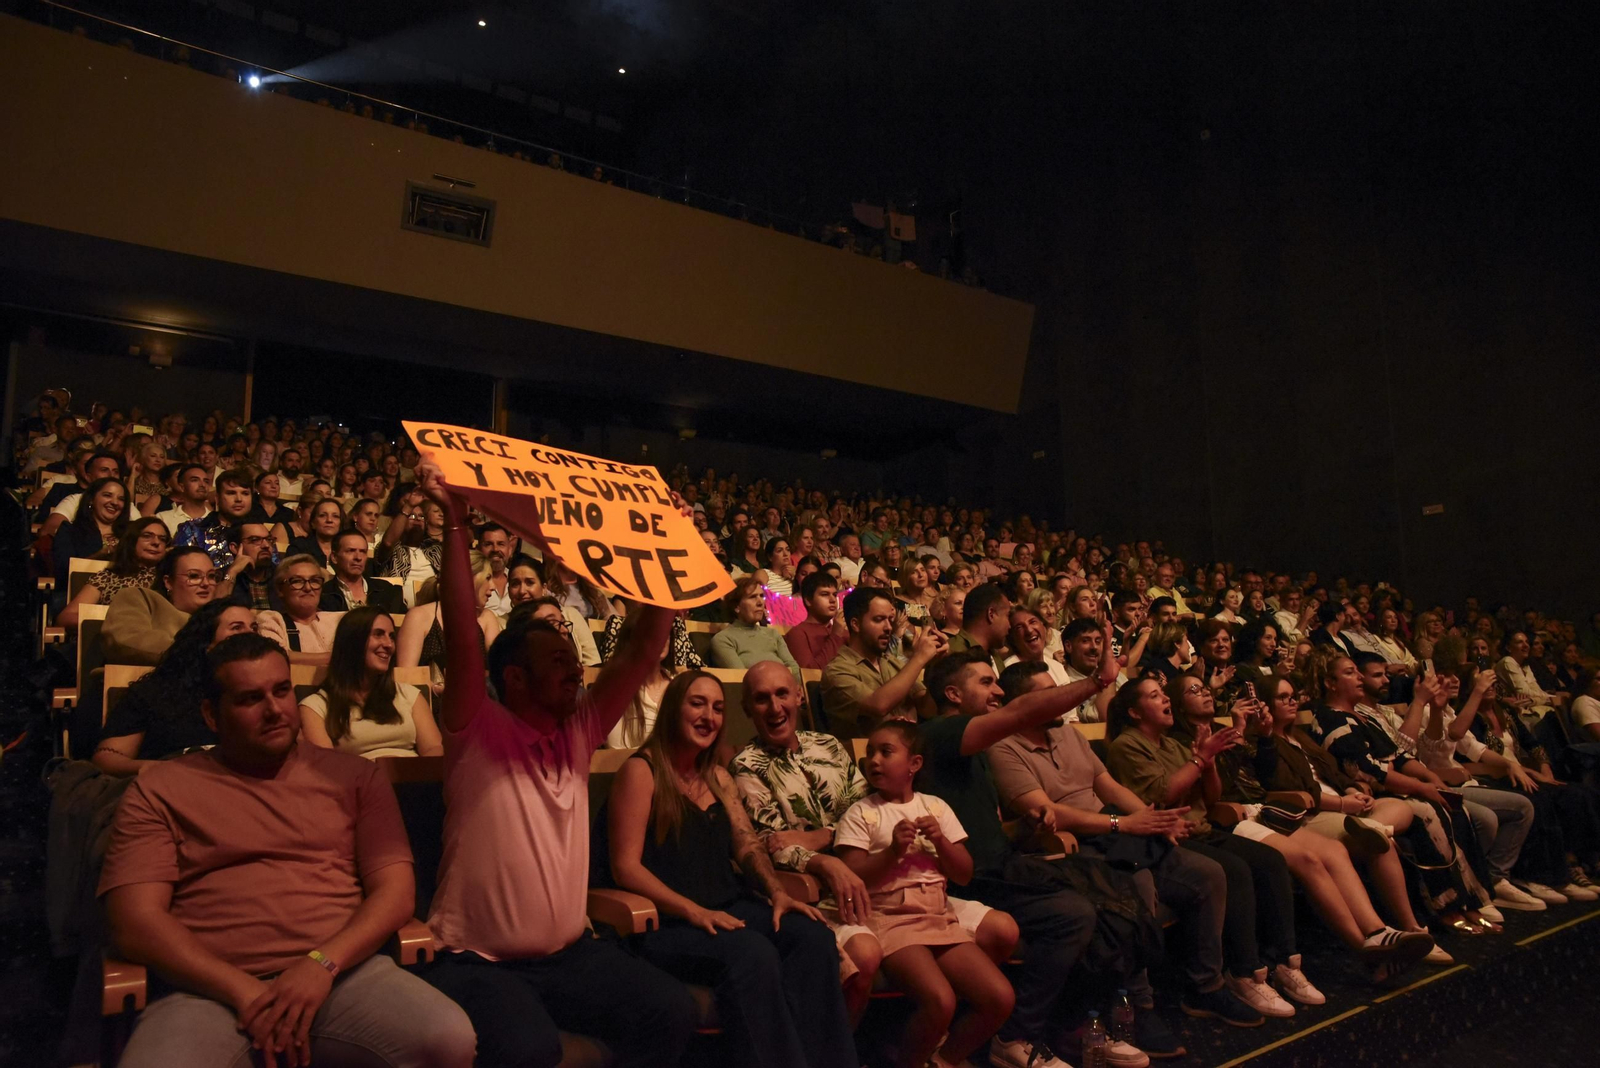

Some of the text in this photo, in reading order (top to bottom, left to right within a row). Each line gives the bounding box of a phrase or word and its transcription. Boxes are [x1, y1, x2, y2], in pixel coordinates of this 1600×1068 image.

[416, 429, 657, 481] CRECI CONTIGO
[462, 461, 489, 487] Y
[502, 467, 556, 491] HOY
[628, 510, 668, 537] DE
